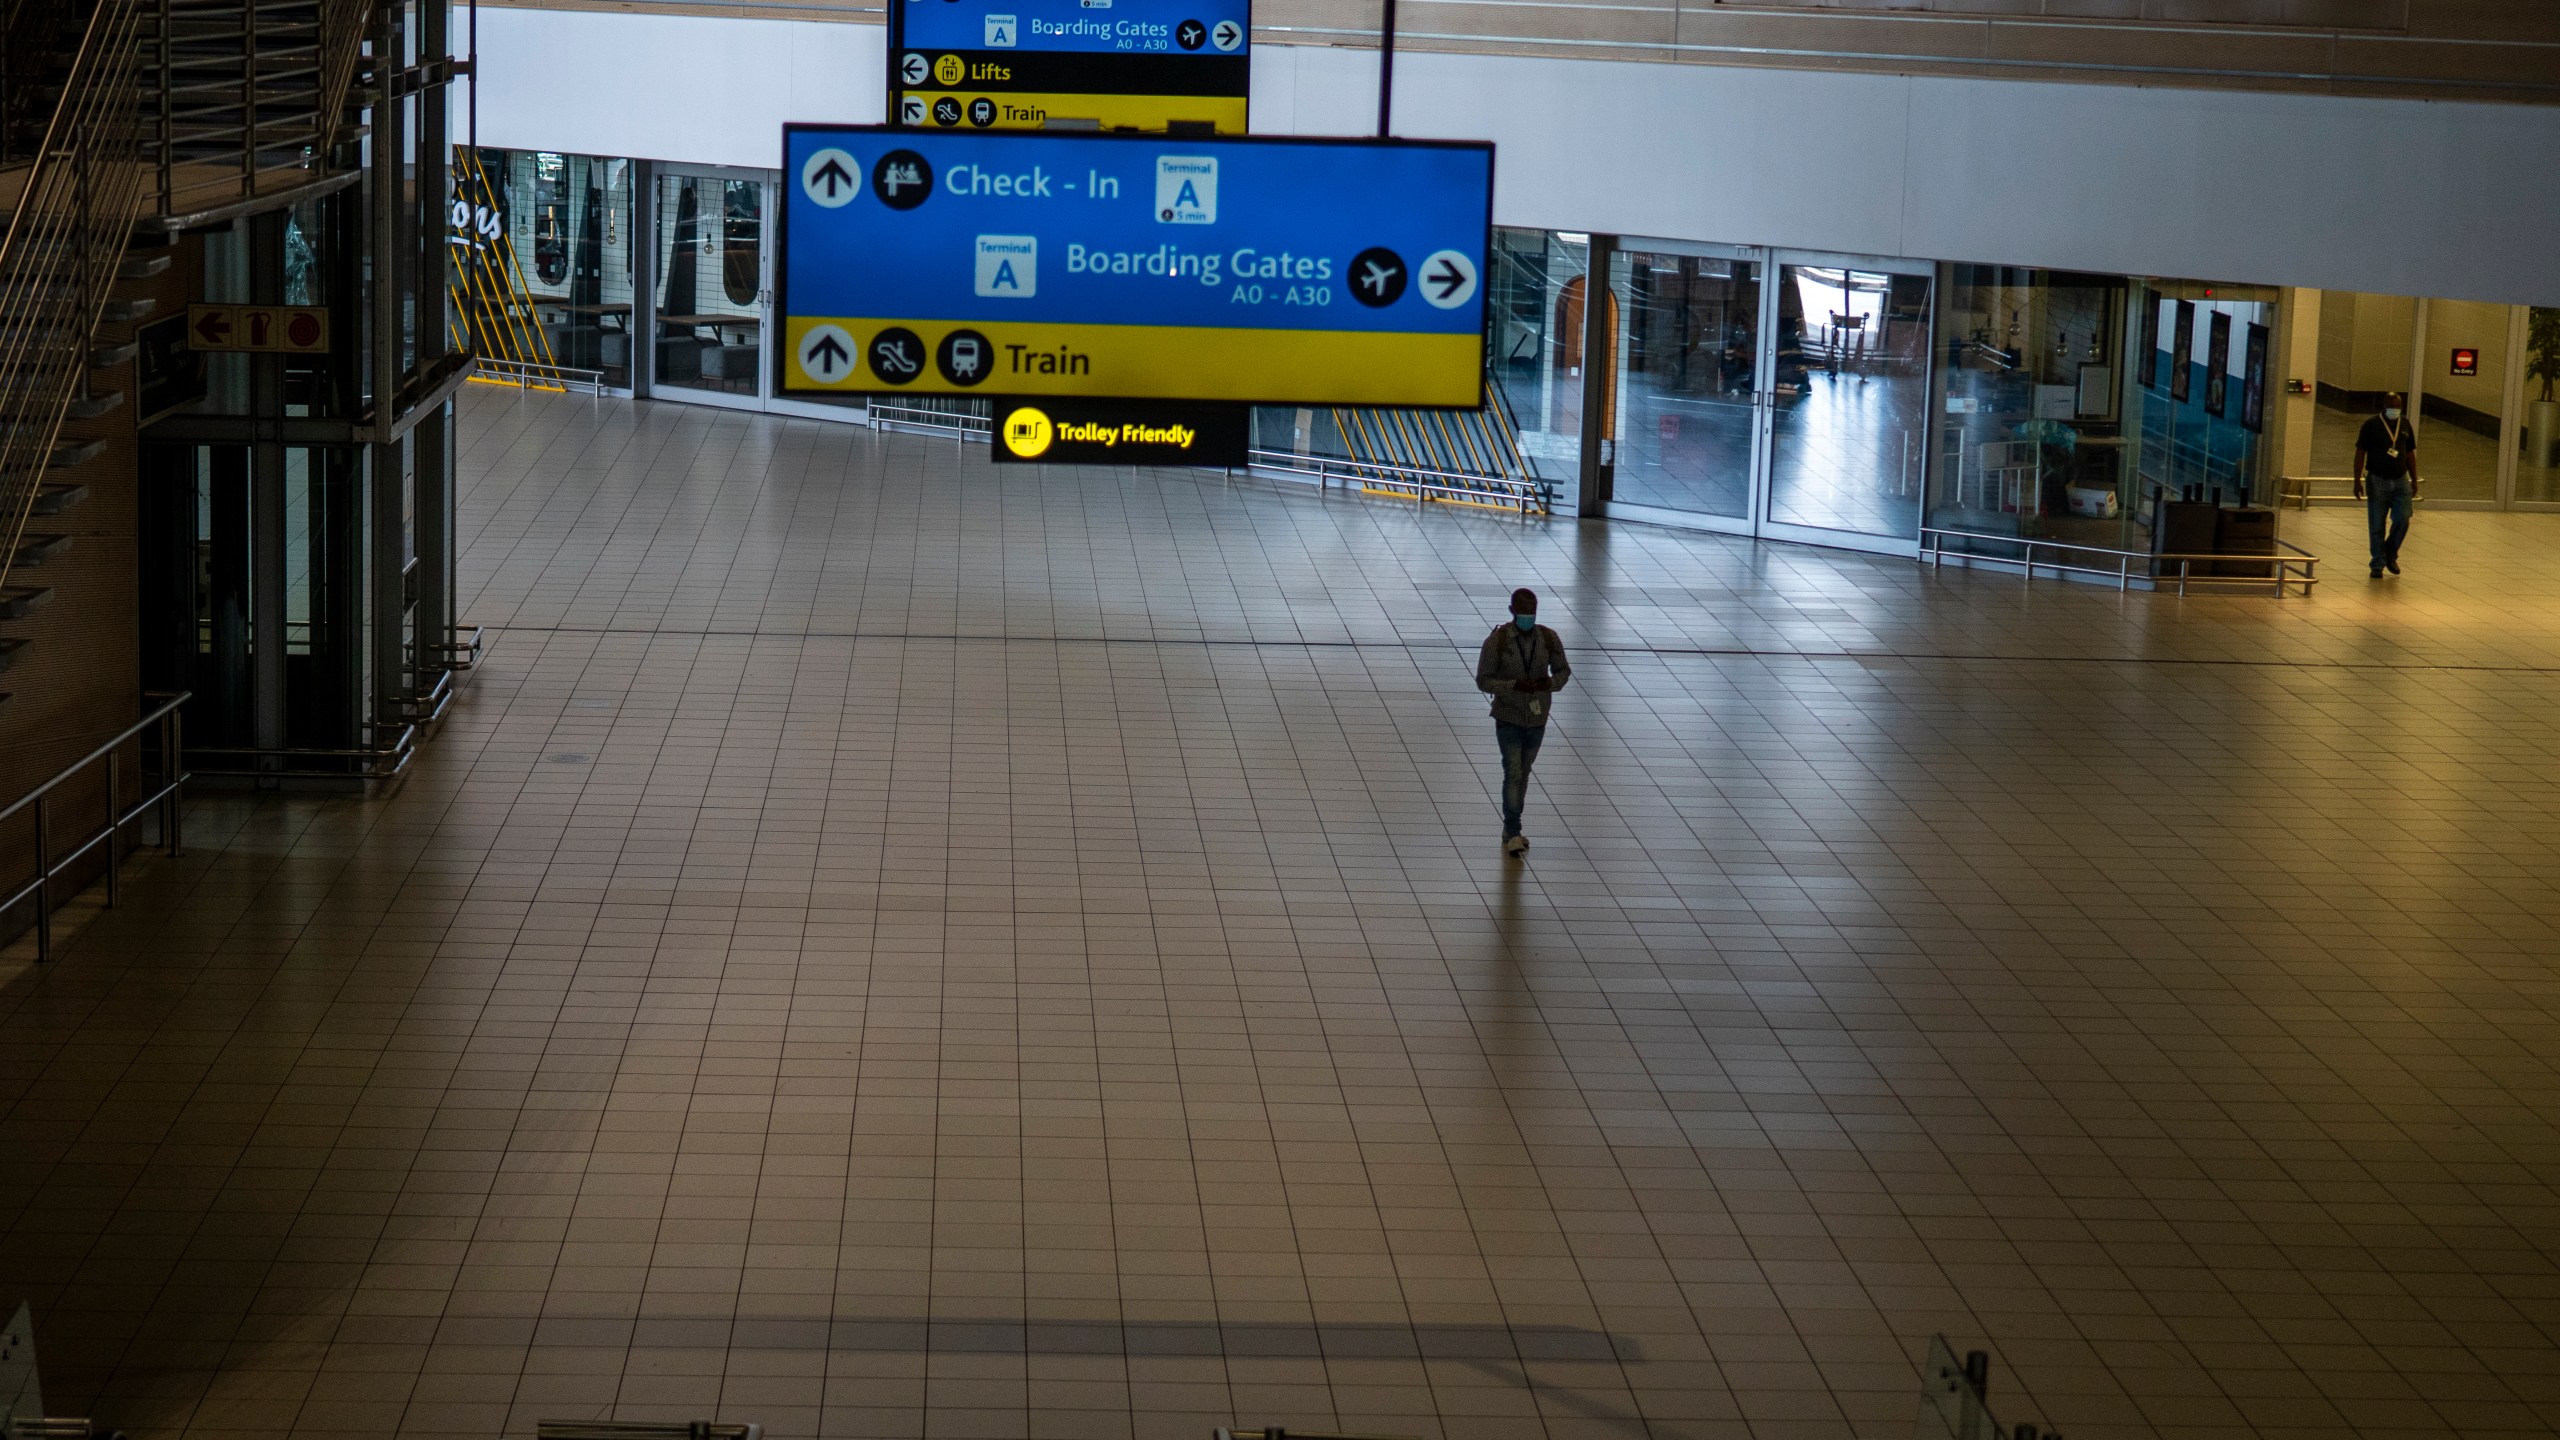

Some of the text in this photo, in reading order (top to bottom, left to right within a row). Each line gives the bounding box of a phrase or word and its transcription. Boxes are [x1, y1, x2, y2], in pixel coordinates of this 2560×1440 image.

[987, 17, 1015, 25] Terminal
[1032, 18, 1168, 40] Boarding Gates
[993, 27, 1008, 43] A
[1116, 39, 1133, 50] A0
[1143, 39, 1168, 50] A30
[971, 64, 1011, 81] Lifts
[1002, 105, 1046, 121] Train
[1162, 162, 1211, 175] Terminal
[946, 165, 1051, 198] Check
[1089, 169, 1120, 199] In
[1175, 179, 1200, 208] A
[1176, 211, 1207, 221] 5 min
[979, 241, 1032, 254] Terminal
[991, 259, 1019, 290] A
[1067, 244, 1332, 286] Boarding Gates
[1231, 285, 1262, 304] A0
[1284, 286, 1331, 306] A30
[1004, 344, 1090, 376] Train
[1056, 423, 1195, 448] Trolley Friendly
